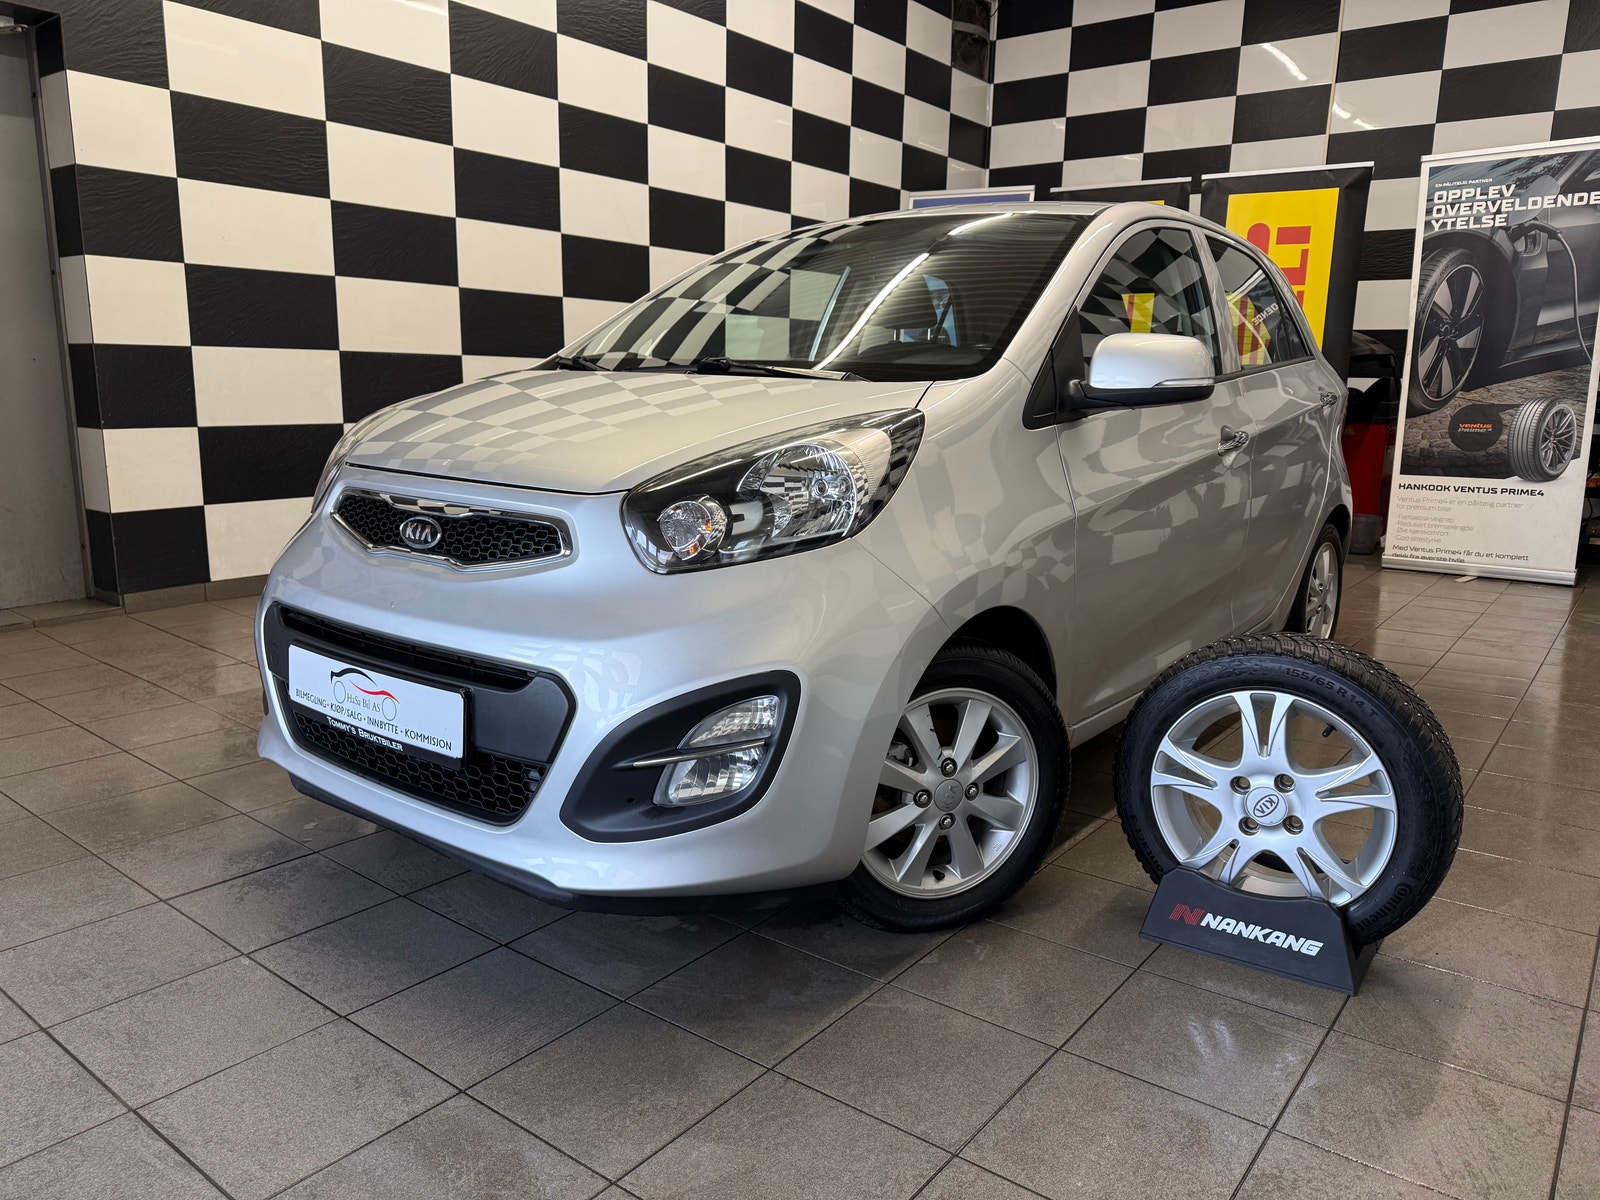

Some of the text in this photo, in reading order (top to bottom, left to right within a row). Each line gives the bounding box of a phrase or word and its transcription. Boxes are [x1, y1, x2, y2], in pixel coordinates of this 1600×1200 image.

[1434, 184, 1517, 204] OPPLEV
[1432, 191, 1600, 218] OVERVELDENDE
[1431, 213, 1508, 232] YTELSE
[1398, 483, 1545, 497] HANKOOK VENTUS PRIME4
[1406, 504, 1437, 512] premium
[1422, 497, 1448, 505] Prime4
[405, 522, 432, 543] KIA
[1409, 545, 1434, 553] Ventus
[1435, 547, 1462, 555] Prime4
[1463, 549, 1474, 557] får
[1495, 552, 1529, 562] komplett
[1284, 667, 1336, 690] 155/65
[362, 698, 371, 710] Bil
[371, 702, 381, 713] AS
[330, 702, 362, 722] KJØP/SALG
[366, 715, 399, 735] INNBYTTE
[404, 728, 452, 751] KOMMISJON
[1255, 796, 1277, 815] KIA
[1200, 912, 1324, 957] NANKANG
